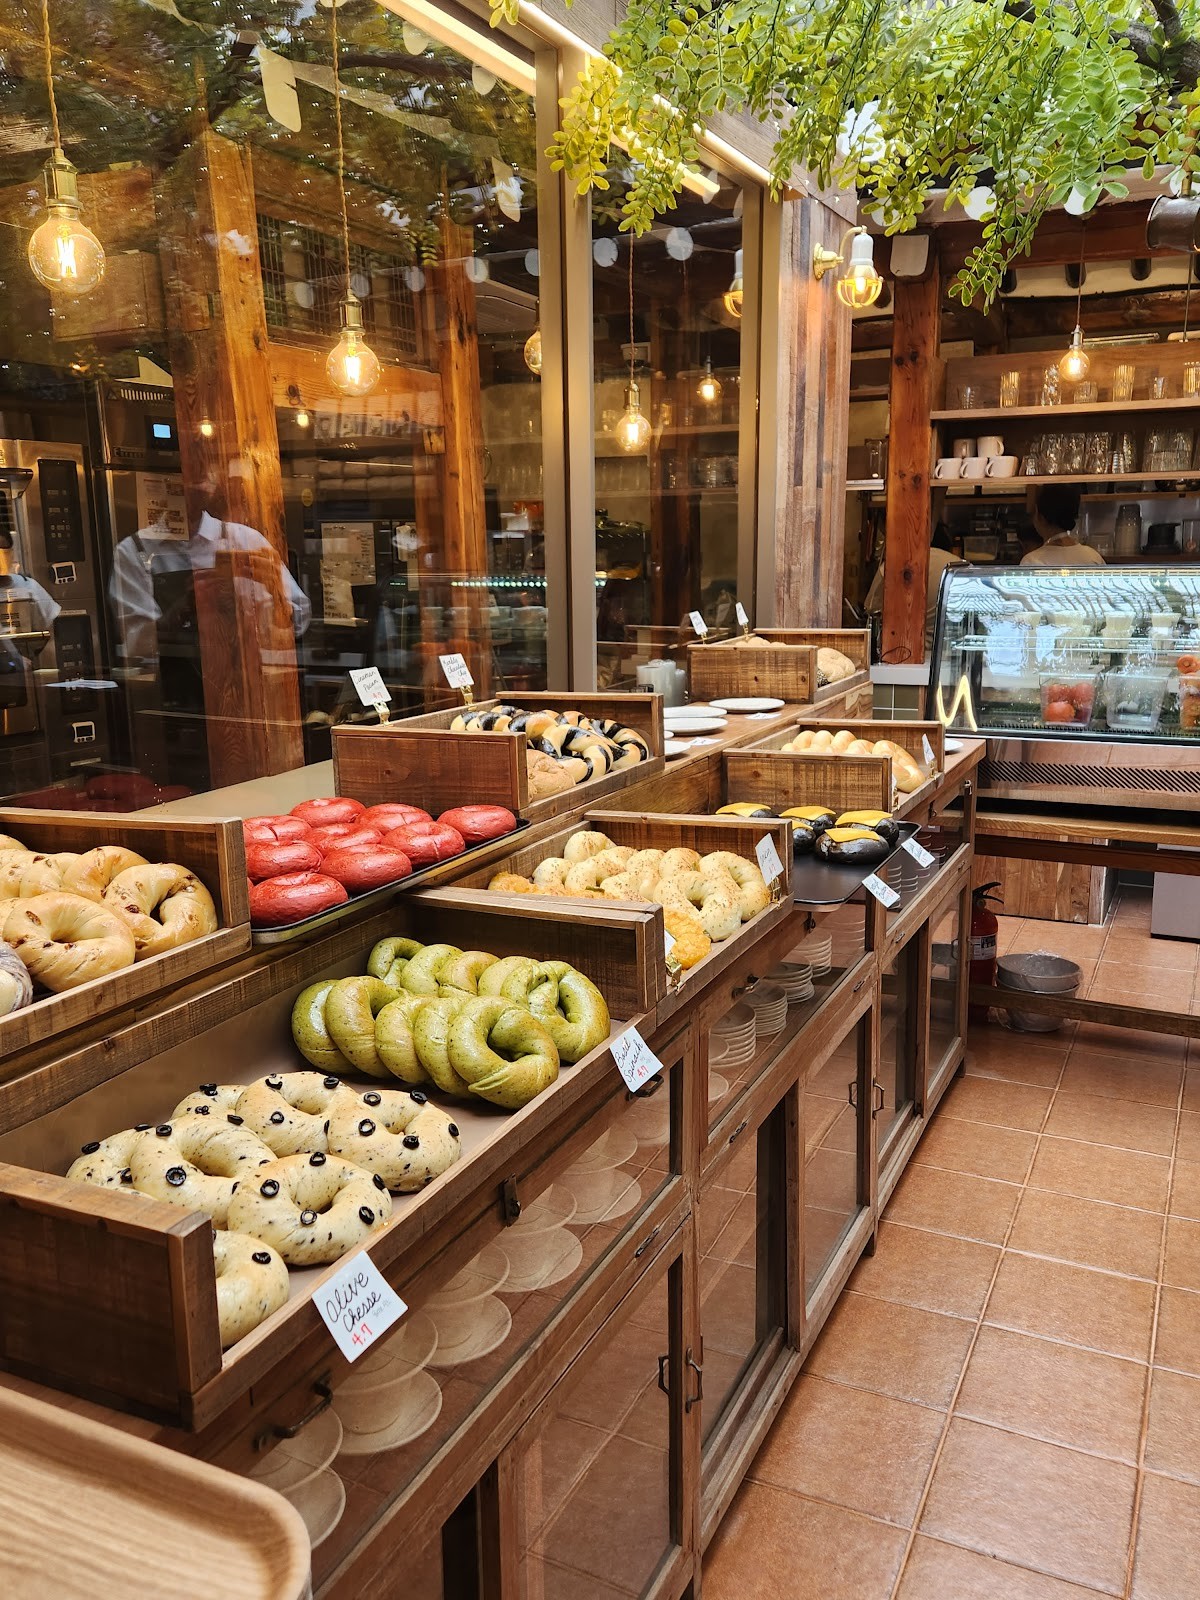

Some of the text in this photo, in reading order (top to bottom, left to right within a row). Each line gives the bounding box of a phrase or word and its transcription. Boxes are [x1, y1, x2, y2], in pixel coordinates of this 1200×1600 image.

[636, 1065, 649, 1078] 4.7
[326, 1272, 369, 1323] Olive
[352, 1323, 373, 1345] 4.7
